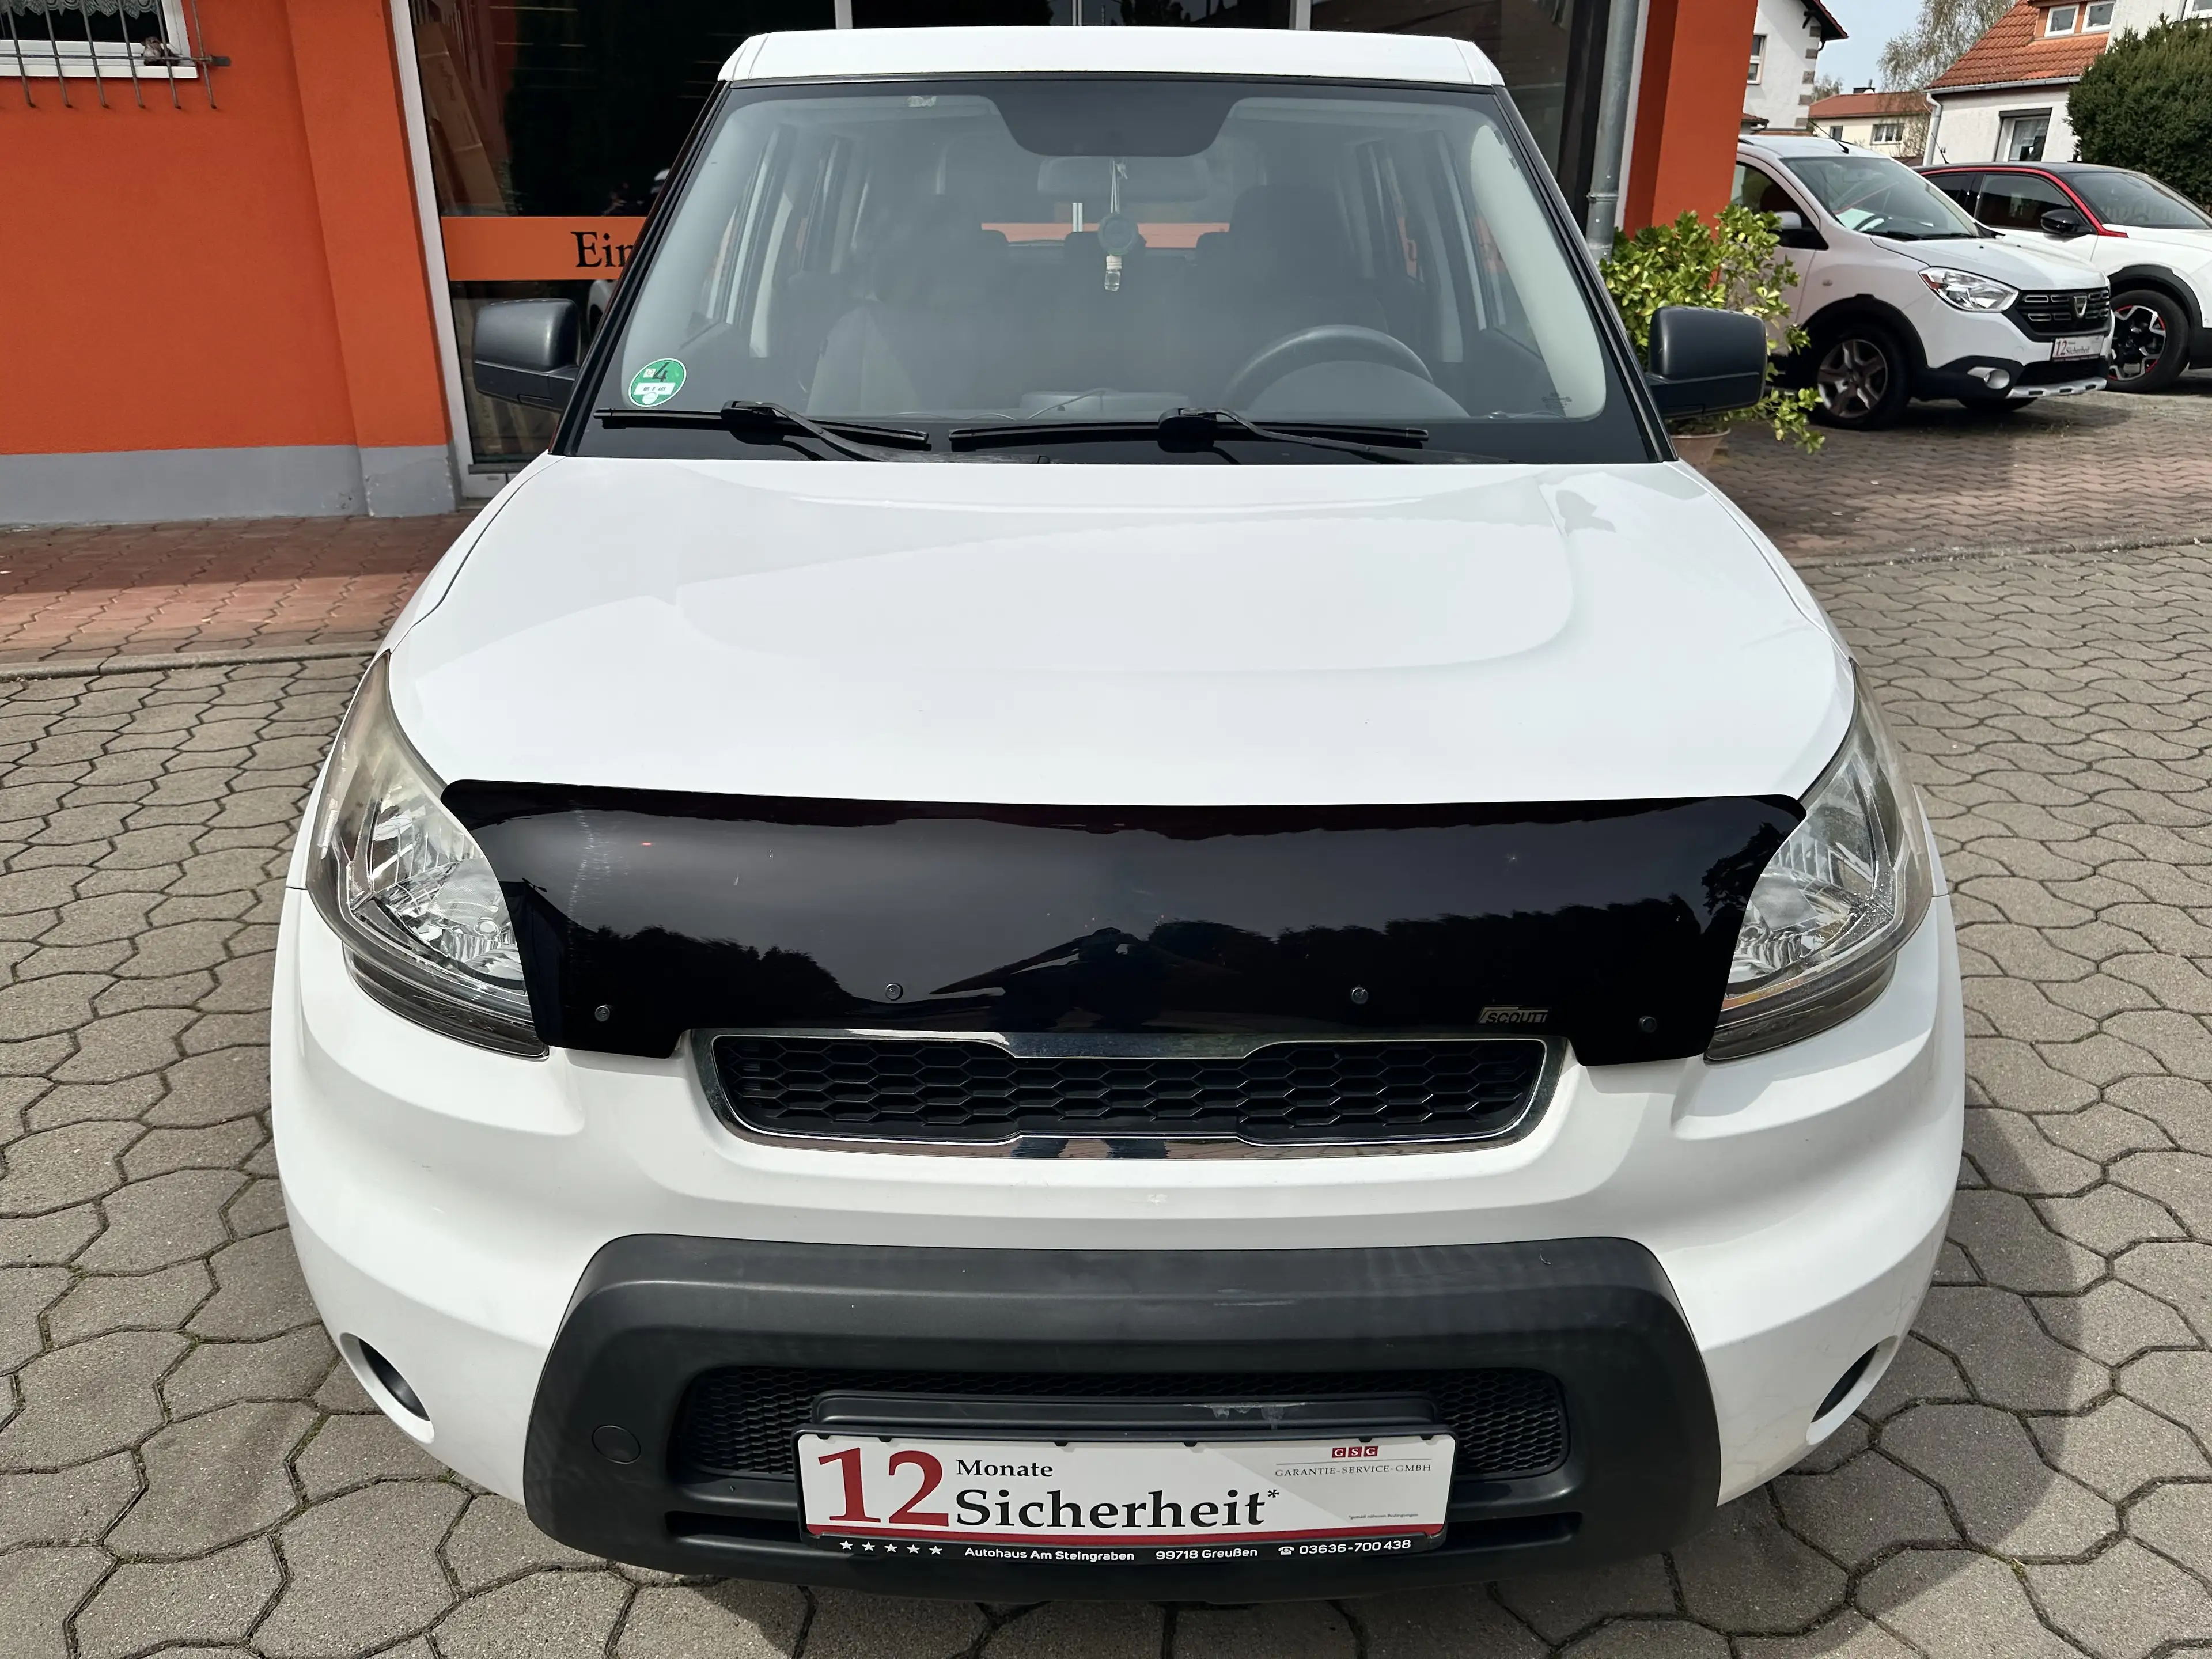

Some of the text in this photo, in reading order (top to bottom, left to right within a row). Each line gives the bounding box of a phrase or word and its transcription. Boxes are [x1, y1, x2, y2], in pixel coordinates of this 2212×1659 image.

[2055, 340, 2067, 356] 12
[652, 362, 671, 382] 4
[1332, 1446, 1377, 1458] GSG
[956, 1459, 1054, 1478] Monate
[1275, 1464, 1432, 1477] GARANTIE-SERVICE-GMBH
[818, 1446, 949, 1525] 12
[964, 1547, 1027, 1559] Autohaus
[1029, 1550, 1052, 1560] Am
[1055, 1551, 1135, 1563] Steingraben
[1156, 1547, 1199, 1560] 99718
[1202, 1548, 1257, 1559] Greußen
